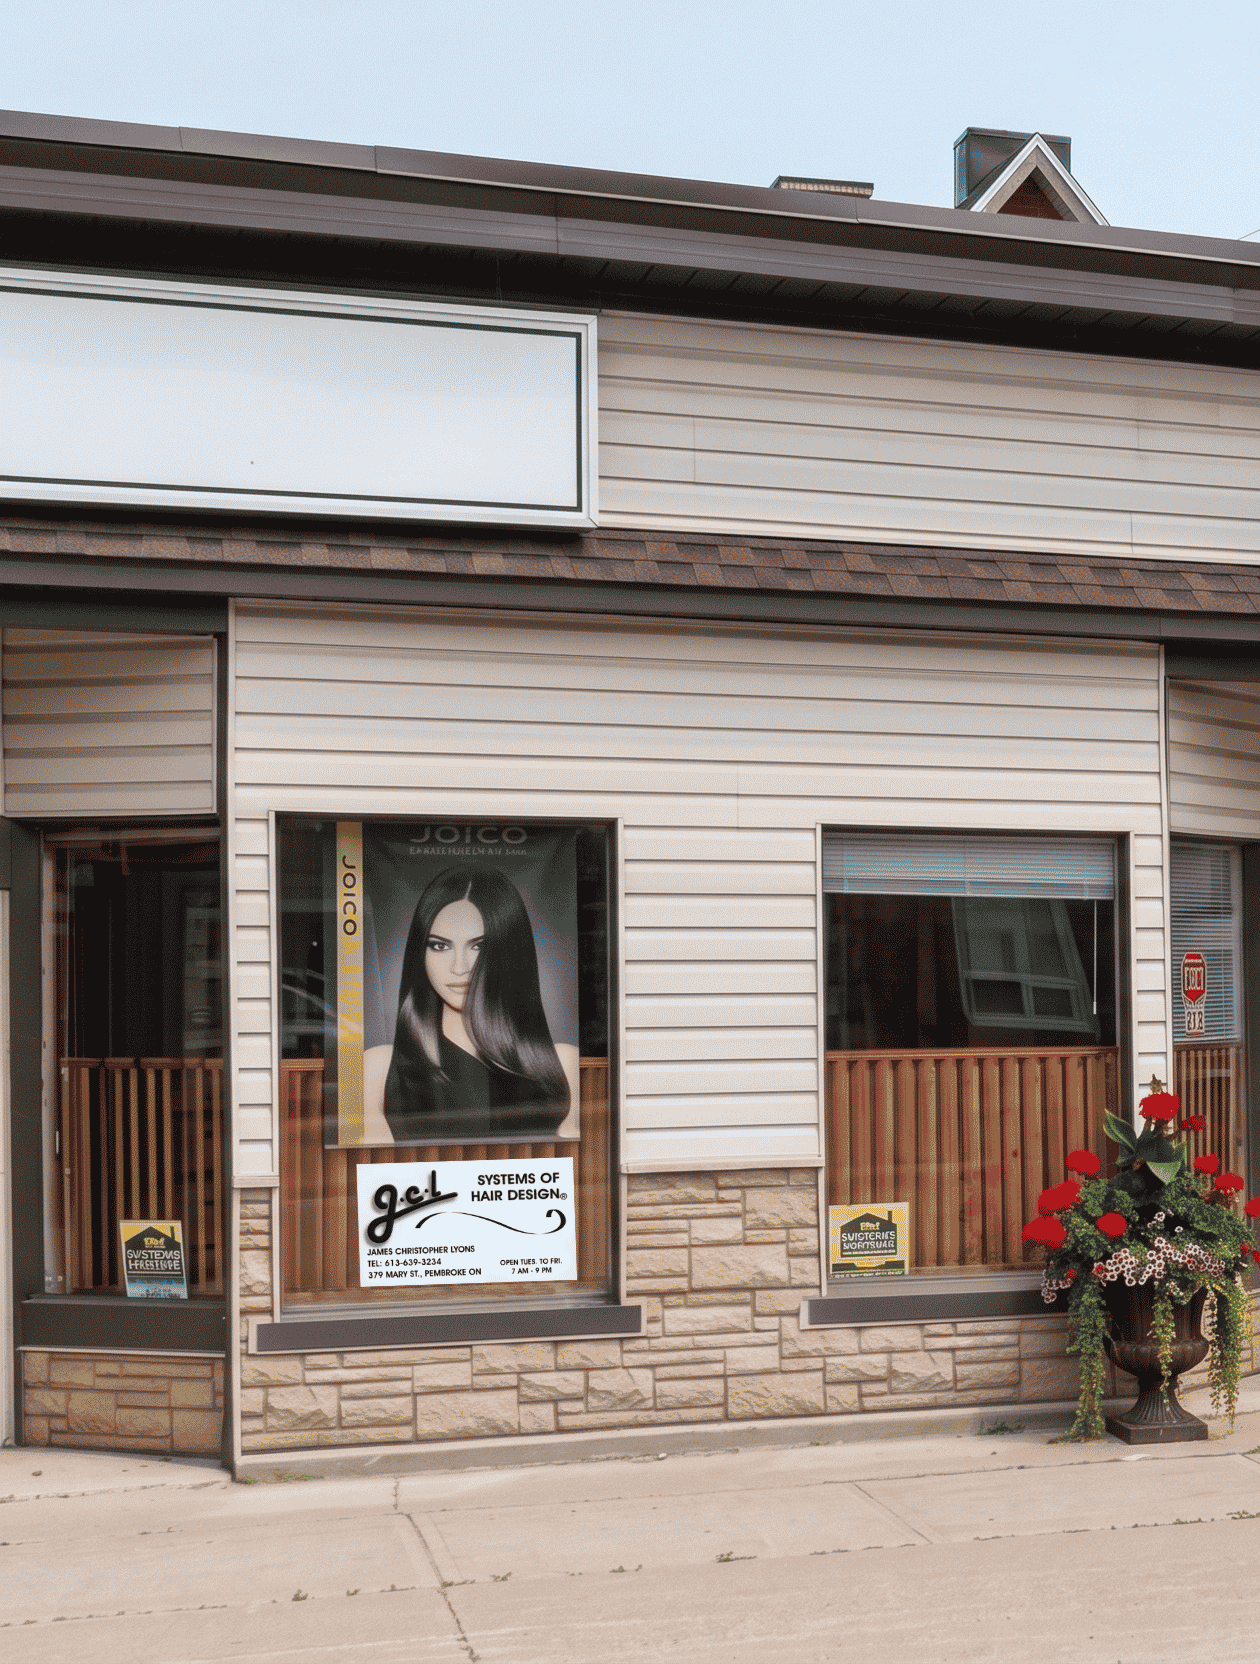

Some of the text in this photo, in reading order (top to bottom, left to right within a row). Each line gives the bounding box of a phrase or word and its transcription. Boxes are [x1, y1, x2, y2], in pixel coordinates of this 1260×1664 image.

[410, 826, 527, 844] JOICO
[342, 855, 357, 936] JOICO
[477, 1172, 560, 1186] SYSTEMS OF
[471, 1190, 503, 1202] HAIR
[367, 1245, 475, 1256] JAMES CHRISTOPHER LYONS
[384, 1258, 442, 1267] 613-639-3234
[539, 1257, 549, 1265] TO
[368, 1271, 383, 1279] 379
[385, 1270, 408, 1278] MARY
[424, 1268, 467, 1277] PEMBROKE
[468, 1267, 482, 1276] ON
